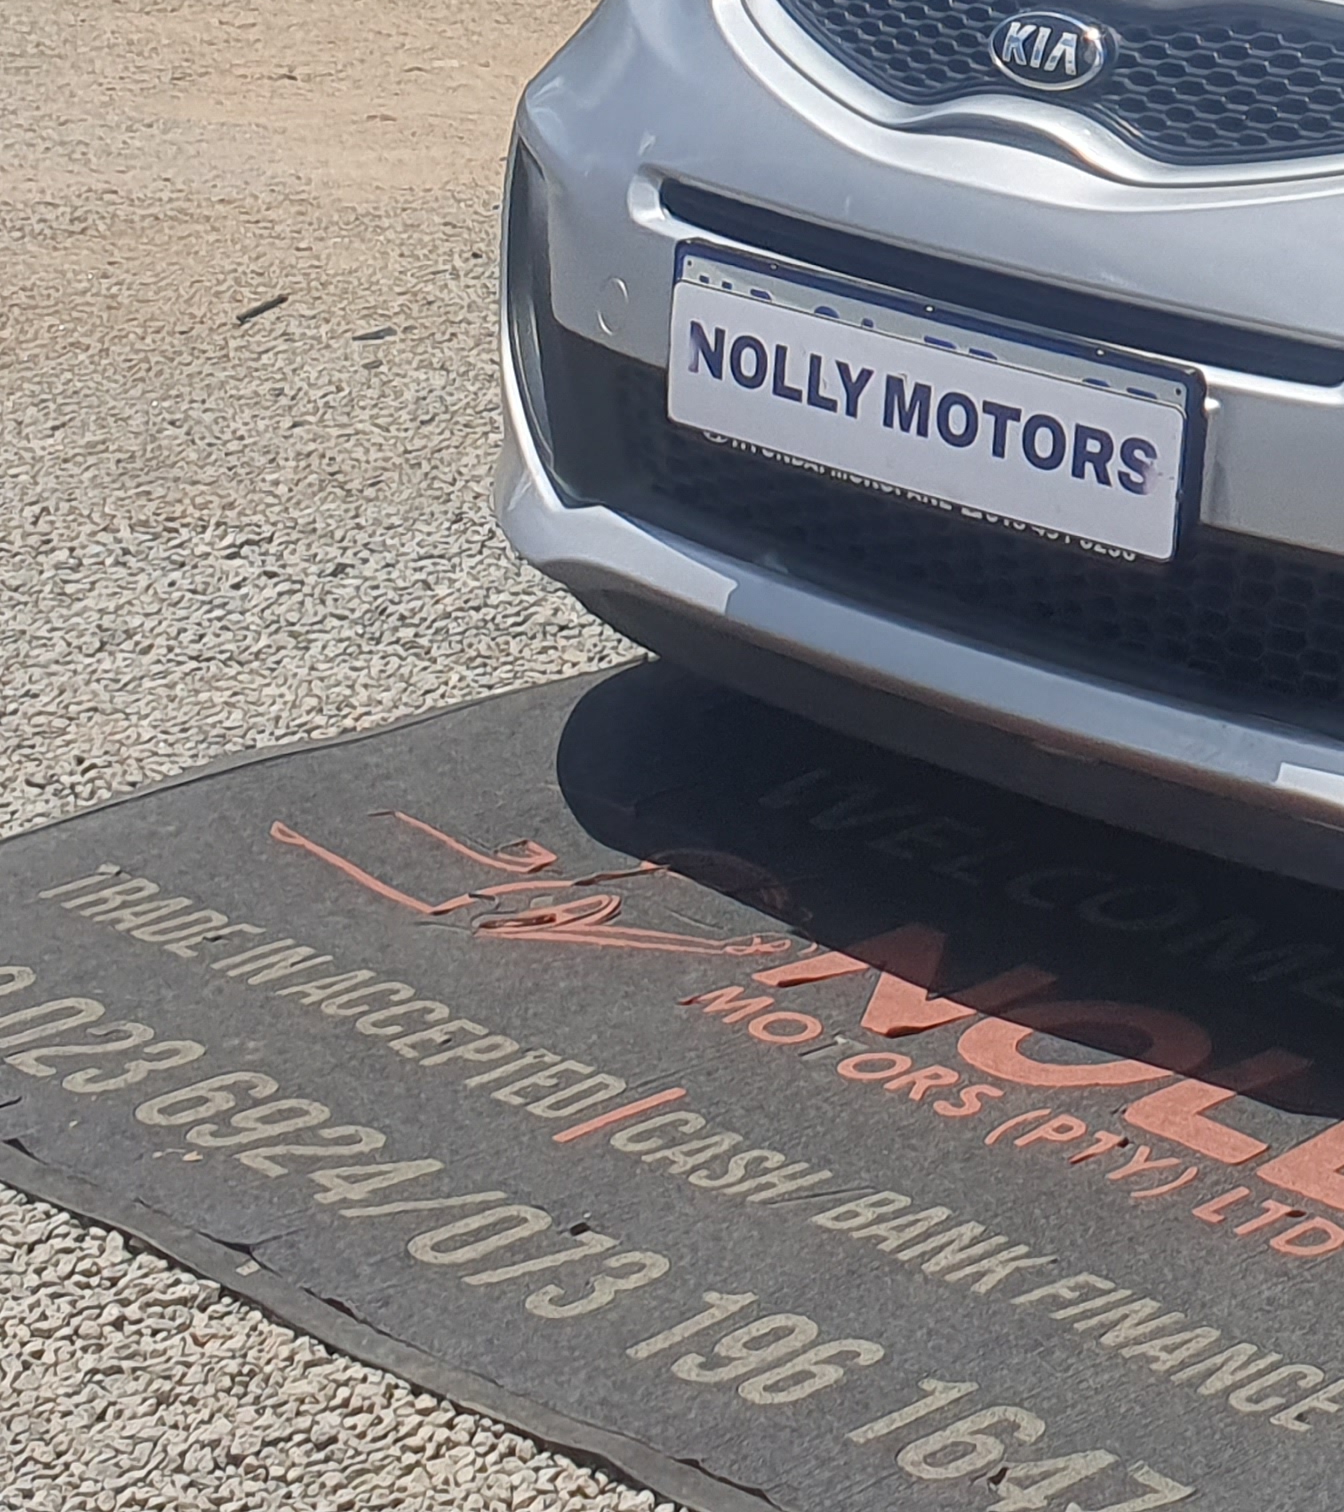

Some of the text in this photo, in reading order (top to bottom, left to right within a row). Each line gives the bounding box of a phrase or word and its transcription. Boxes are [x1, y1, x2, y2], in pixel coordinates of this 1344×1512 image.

[1002, 21, 1077, 76] KIA
[688, 320, 873, 418] NOLLY
[882, 374, 1159, 495] MOTORS
[38, 862, 266, 957] TRADE
[209, 938, 334, 986] IN
[679, 985, 1005, 1117] MOTORS
[985, 1108, 1199, 1199] (PTY)
[625, 1290, 885, 1405] 196
